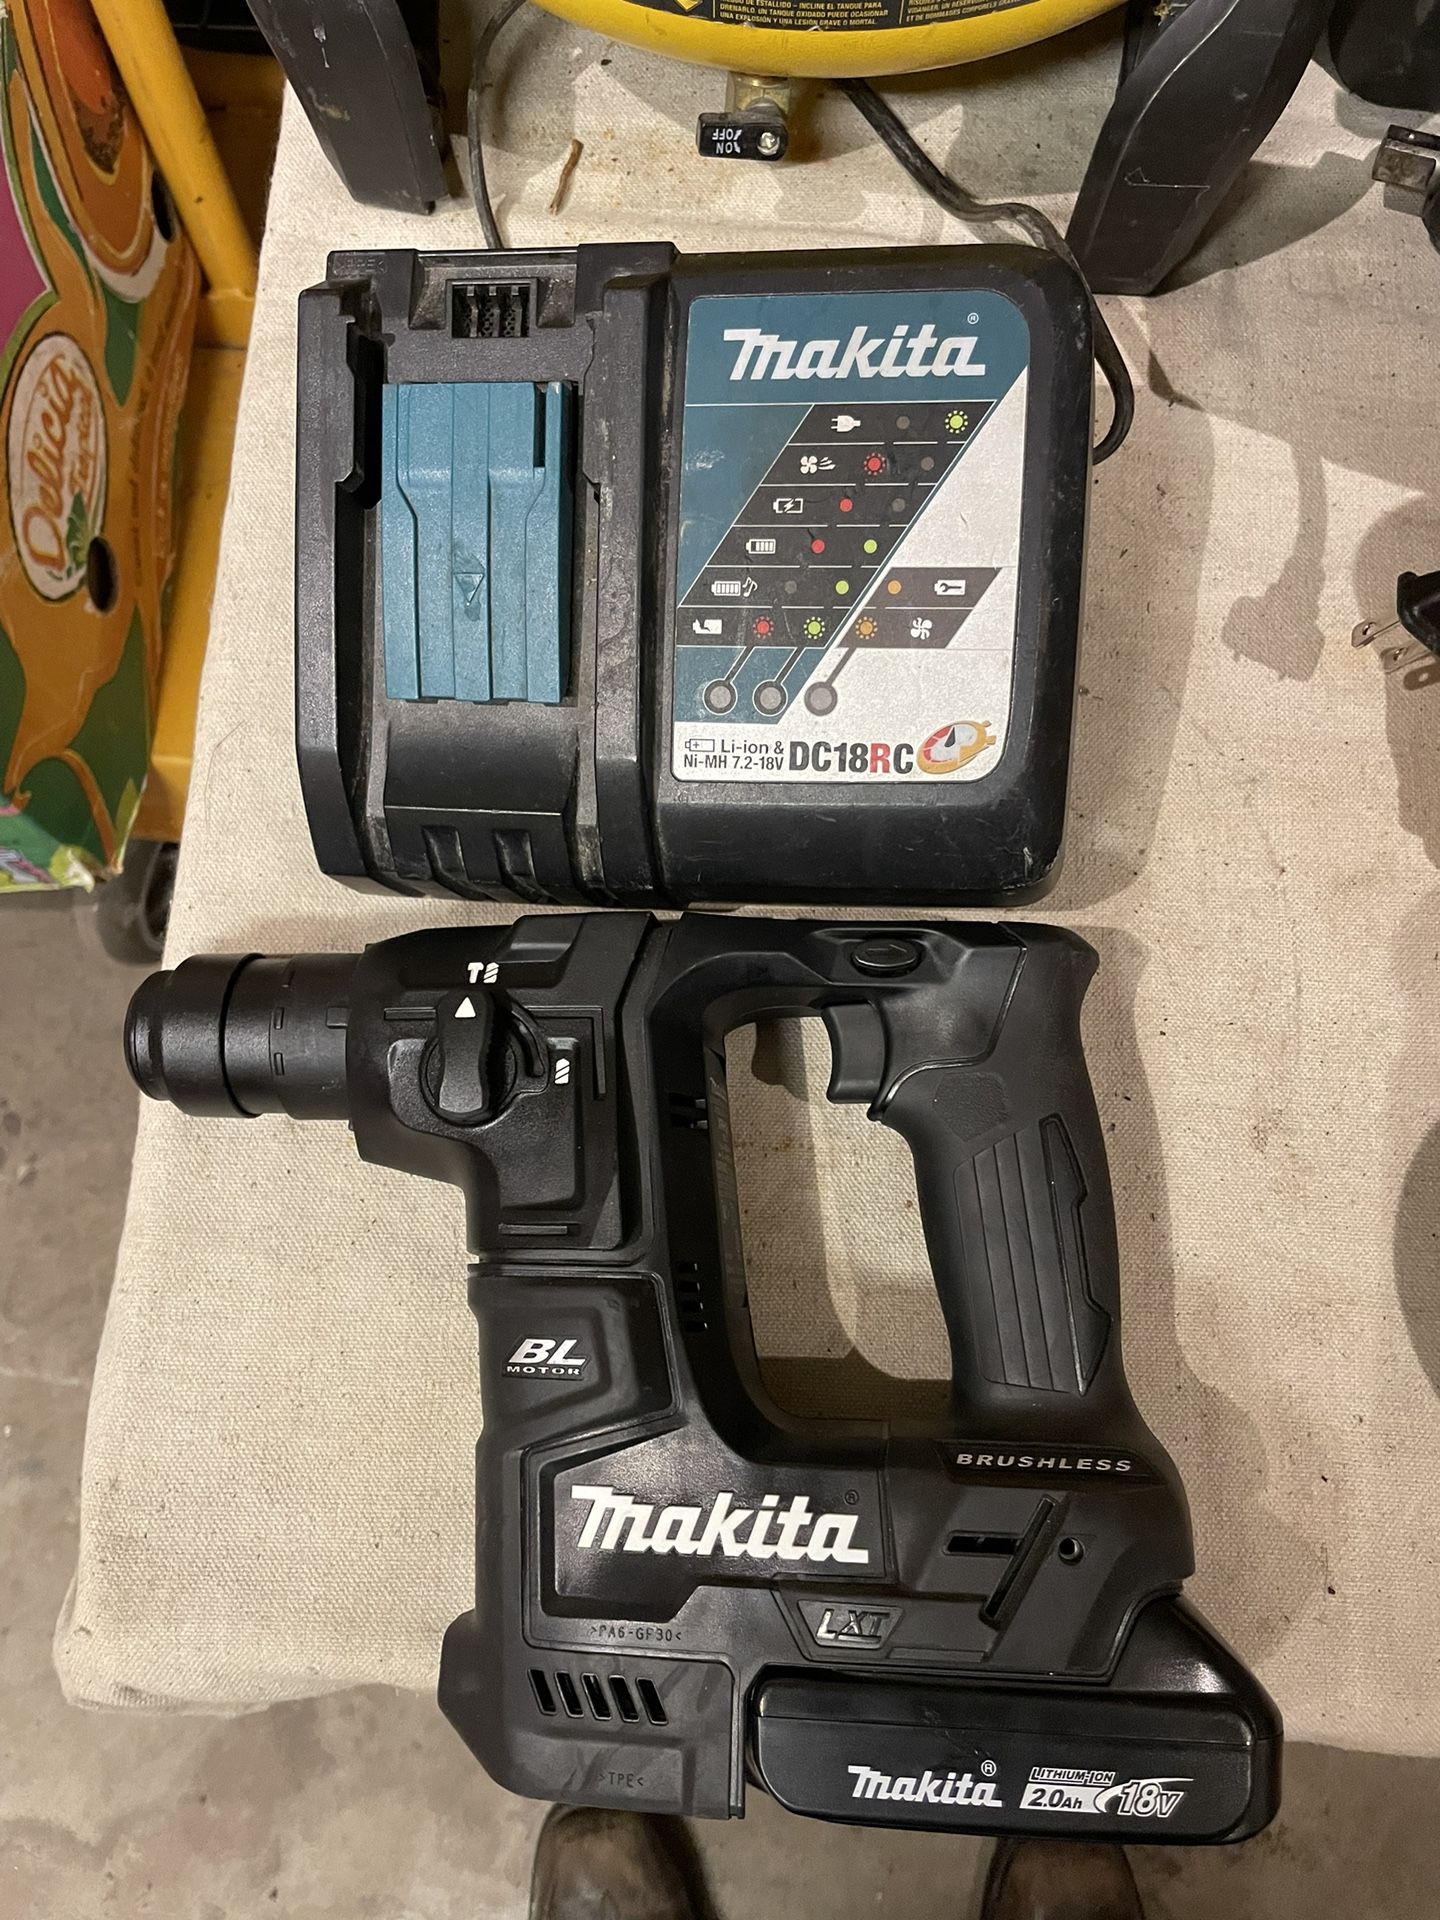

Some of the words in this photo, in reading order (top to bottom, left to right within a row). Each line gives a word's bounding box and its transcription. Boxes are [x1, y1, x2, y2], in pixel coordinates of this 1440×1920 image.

[769, 8, 794, 17] TANQUE
[796, 10, 826, 18] OXIDADO
[850, 9, 889, 18] OCASIONAR
[837, 2, 862, 10] TANQUE
[720, 11, 734, 19] UNA
[735, 13, 772, 23] EXPLOSIÓN
[794, 18, 818, 26] LESIÓN
[712, 128, 734, 140] OFF
[716, 141, 733, 154] ON
[720, 740, 769, 754] Li-ion
[773, 741, 785, 754] &
[683, 753, 728, 769] Ni-MH
[733, 755, 785, 771] 7.2-18V
[788, 741, 914, 775] DC18RC
[508, 1338, 586, 1366] BL
[506, 1365, 581, 1375] MOTOR
[956, 1453, 1132, 1472] BRUSHLESS
[816, 1608, 891, 1643] LXT
[1029, 1767, 1115, 1786] LITHIUM-ION
[1027, 1787, 1084, 1809] 2.0Ah
[1117, 1779, 1185, 1818] 18V
